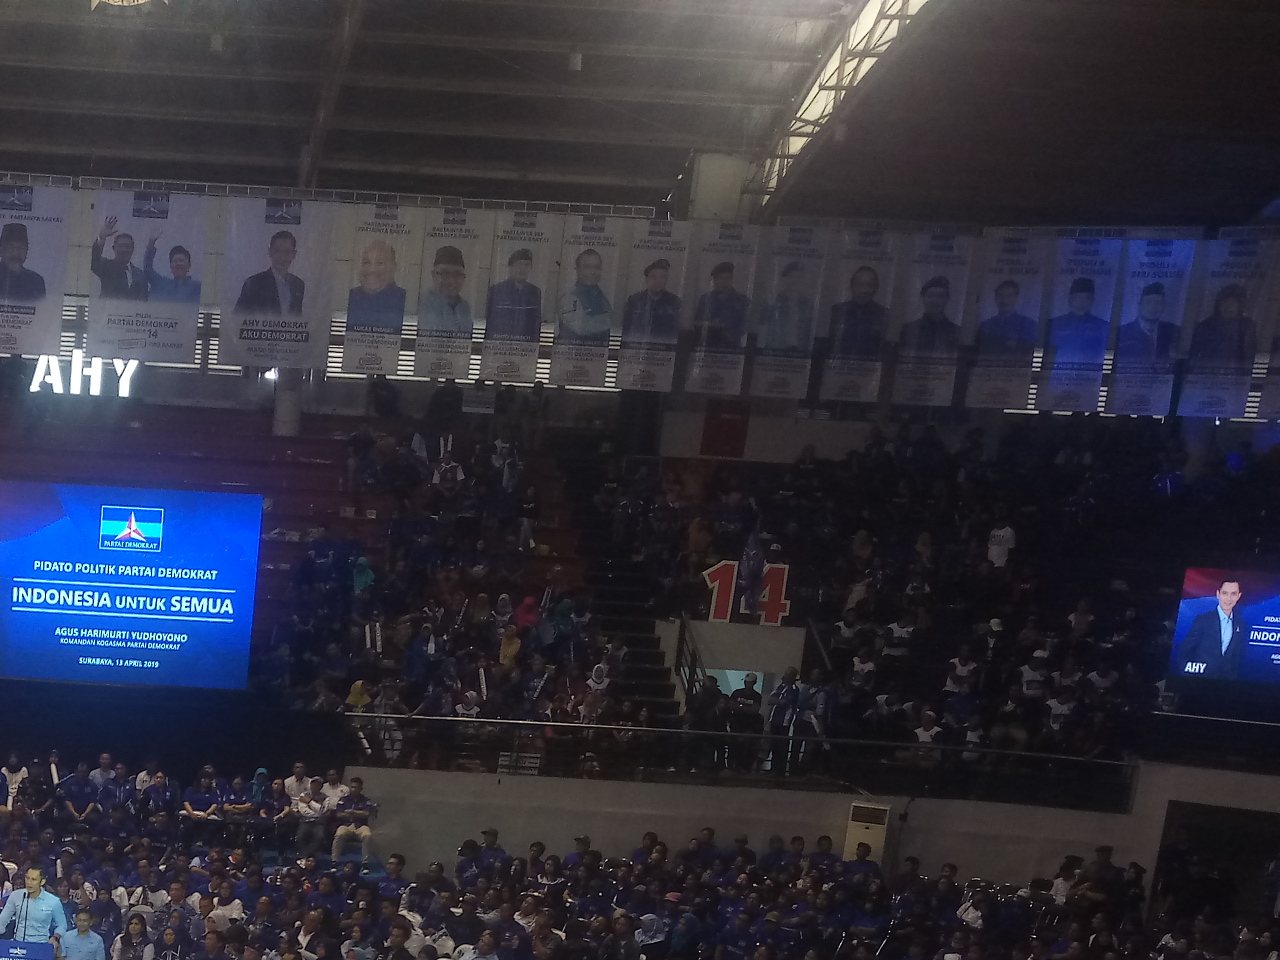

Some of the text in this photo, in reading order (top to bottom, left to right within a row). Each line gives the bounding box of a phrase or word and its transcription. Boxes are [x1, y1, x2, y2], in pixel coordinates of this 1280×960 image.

[107, 317, 179, 329] PARTAI DEMOKRAT
[242, 319, 309, 330] AHY DEMOKRAT
[147, 329, 158, 339] 14
[242, 330, 308, 341] AKU DEMOKRAT
[29, 349, 139, 398] AHY
[103, 540, 158, 550] PARTAI DEMOKRAT
[33, 560, 219, 581] PIDATO POLITIK PARTAI DEMOKRAT
[702, 560, 790, 626] 14
[11, 586, 235, 615] INDONESIA UNTUK SEMUA
[54, 627, 189, 643] AGUS HARIMURTI YUDHOYONO
[60, 638, 182, 651] KOMANDAN KOGASMA PARTAI DEMOKRAT
[78, 656, 160, 669] SURABAYA, 13 APRIL 2019
[1184, 661, 1207, 673] AHY
